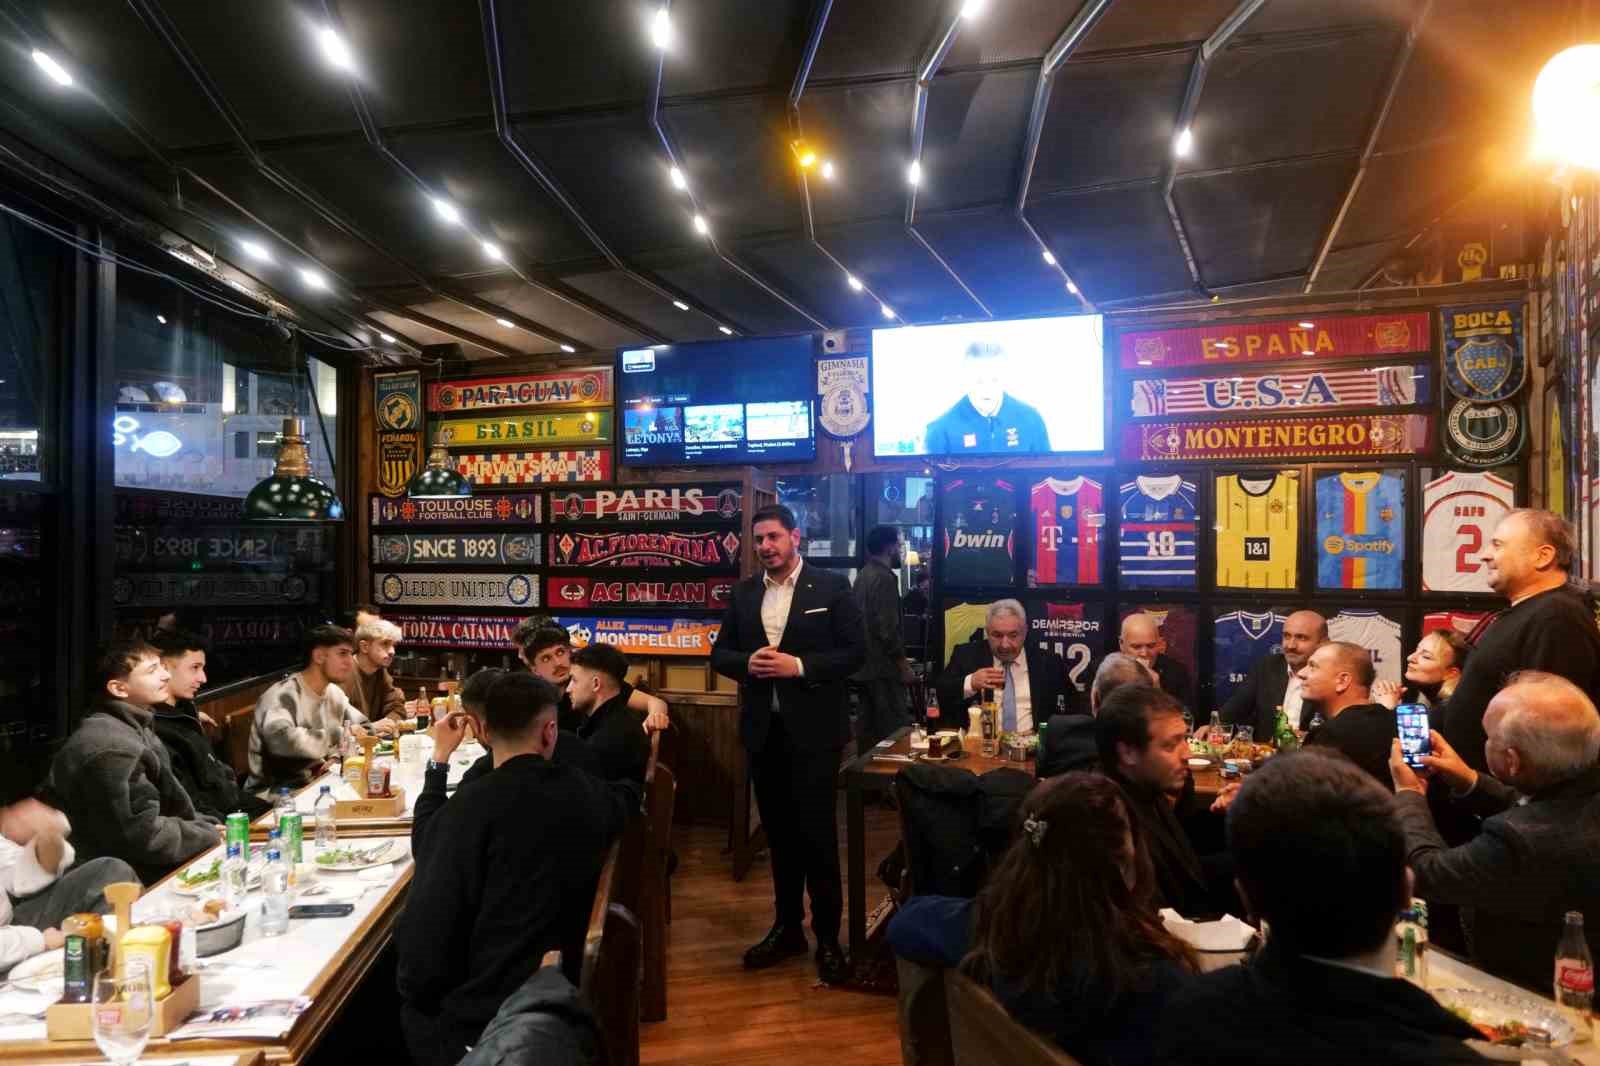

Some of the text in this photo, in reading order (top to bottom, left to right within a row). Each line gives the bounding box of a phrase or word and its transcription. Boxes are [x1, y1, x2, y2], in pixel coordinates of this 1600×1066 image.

[1453, 309, 1512, 329] BOCA
[1200, 327, 1335, 359] ESPAÑA
[460, 381, 574, 407] PARAGUAY
[1200, 372, 1338, 409] U.S.A
[476, 421, 558, 439] BRASIL
[1184, 423, 1367, 449] MONTENEGRO
[466, 459, 569, 478] HRVATSKA
[419, 499, 493, 511] TOULOUSE
[595, 488, 704, 519] PARIS
[419, 511, 493, 520] FOOTBALL CLUB
[618, 511, 680, 520] SAINT-GERMAIN
[953, 529, 1005, 548] bwin
[1041, 526, 1063, 551] T
[1345, 539, 1393, 555] Spotify
[413, 539, 497, 558] SINCE 1893
[1246, 542, 1268, 555] 1&1
[1456, 524, 1482, 573] 2
[402, 581, 506, 598] LEEDS UNITED
[591, 582, 706, 603] AC MILAN
[402, 621, 511, 641] FORZA CATANIA
[595, 633, 702, 648] MONTPELLIER
